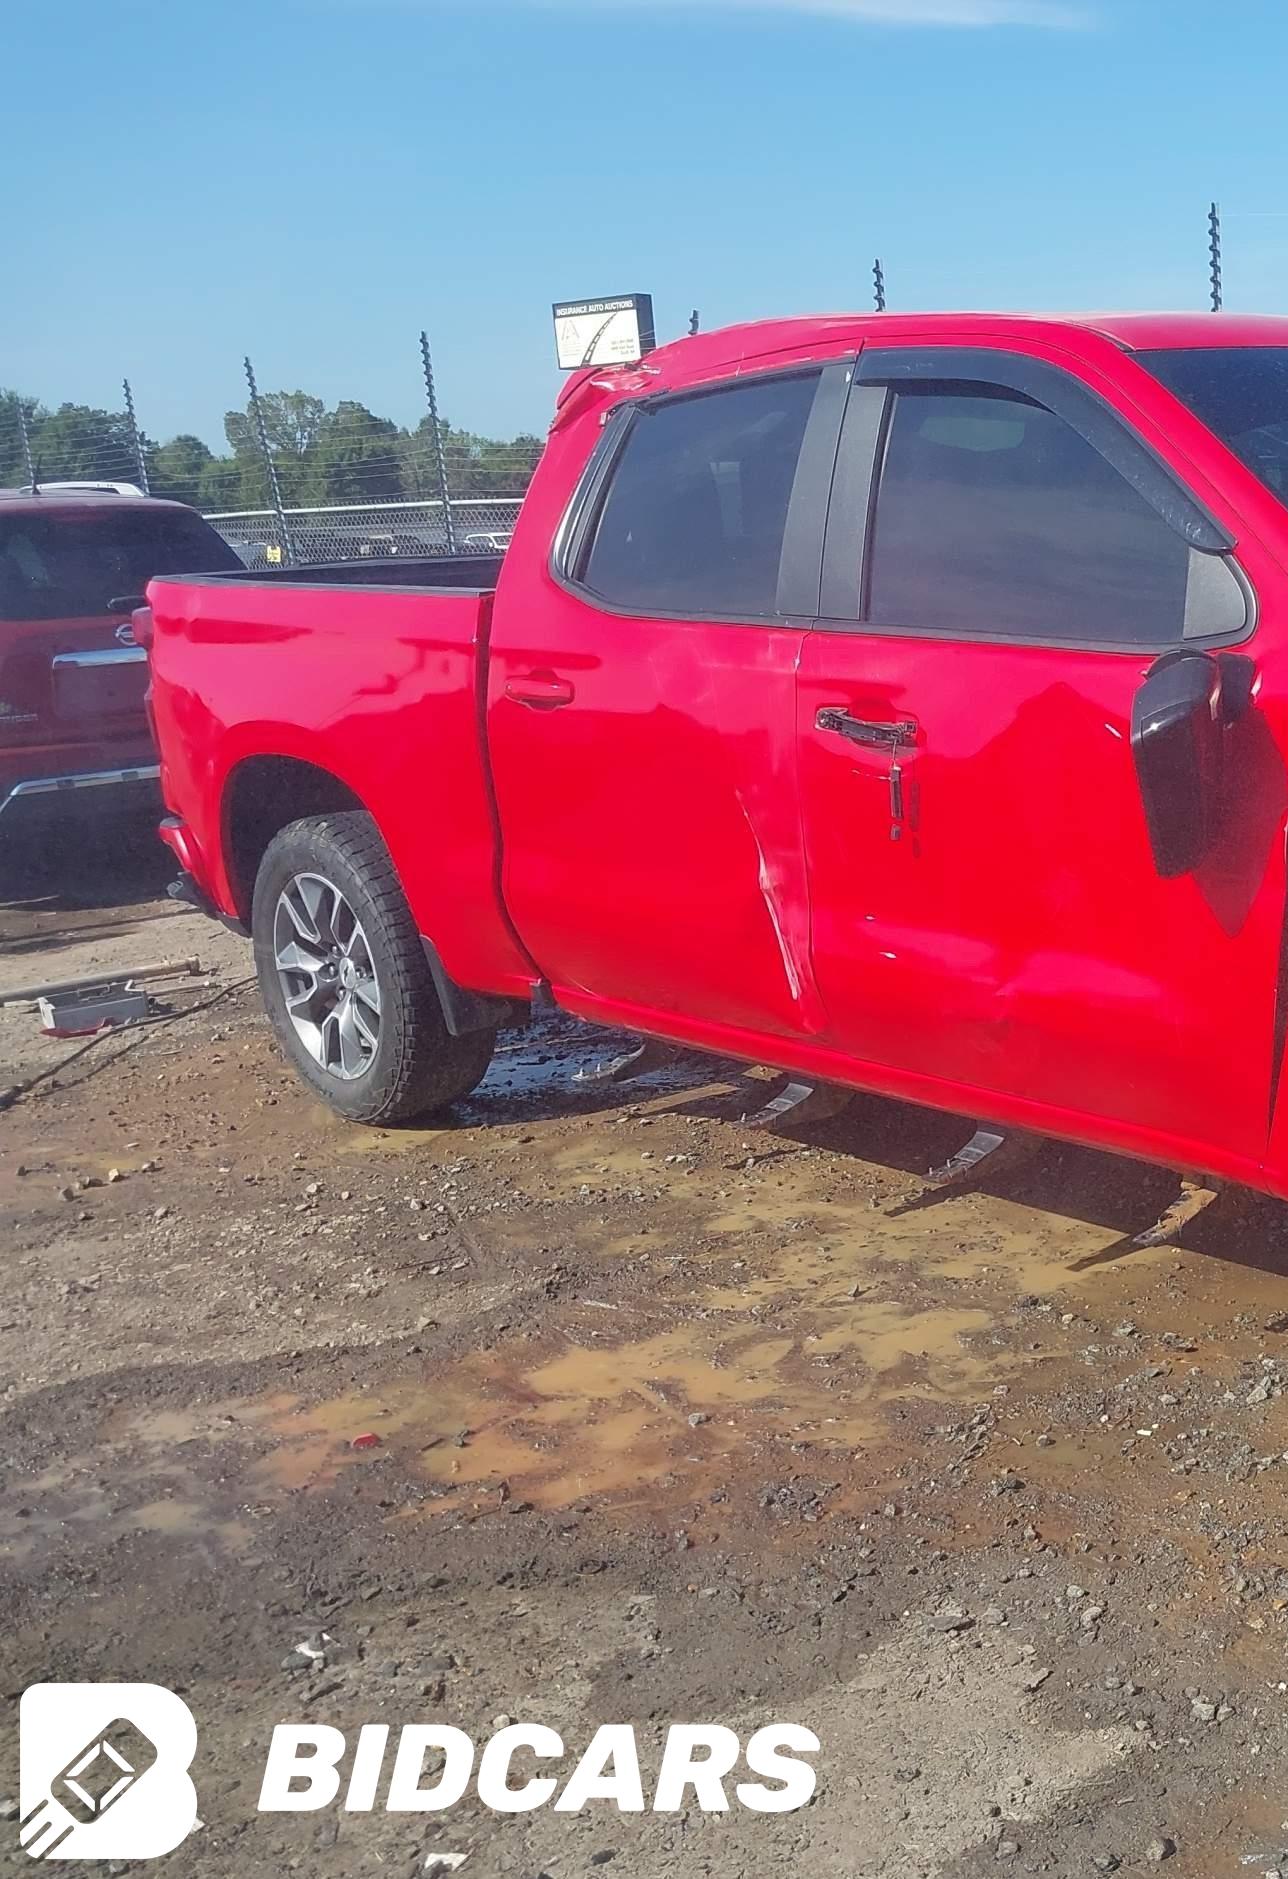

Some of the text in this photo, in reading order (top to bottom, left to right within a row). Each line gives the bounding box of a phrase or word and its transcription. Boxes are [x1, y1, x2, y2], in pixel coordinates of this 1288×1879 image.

[557, 300, 633, 316] INSURANCE AUTO AUCTIONS
